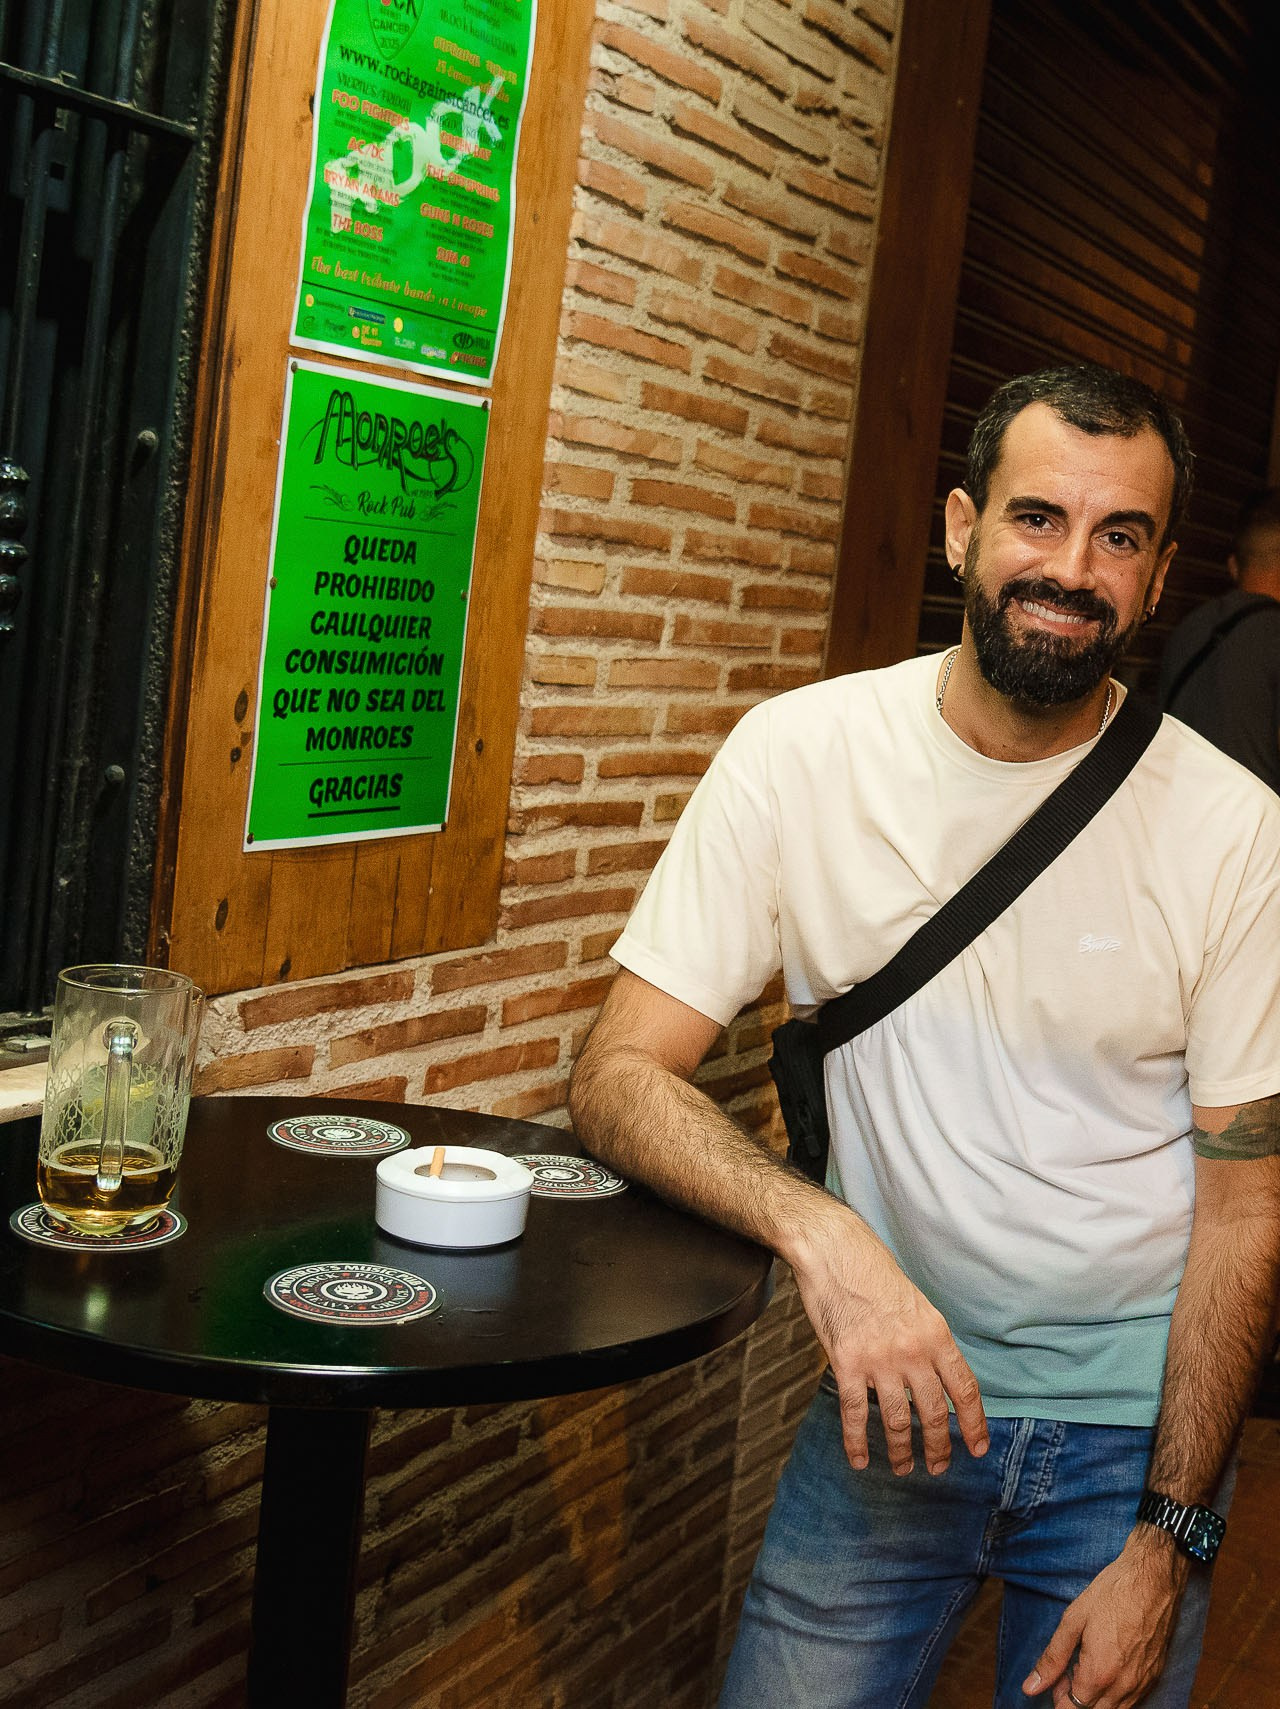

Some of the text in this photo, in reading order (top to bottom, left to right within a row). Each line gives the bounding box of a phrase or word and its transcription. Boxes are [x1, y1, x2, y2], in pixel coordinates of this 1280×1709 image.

[373, 19, 410, 34] CANCER
[332, 88, 359, 111] FOO
[361, 100, 409, 131] FIGHTERS
[347, 137, 384, 161] AC/DC
[324, 168, 359, 193] BRYAN
[362, 183, 400, 207] ADAMS
[426, 163, 444, 182] THE
[333, 213, 383, 242] THE BOSS
[421, 203, 450, 223] GUNS
[462, 216, 494, 238] ROSES
[312, 256, 331, 275] The
[334, 260, 359, 282] best
[361, 271, 400, 293] tribute
[404, 280, 435, 302] bands
[358, 491, 387, 516] Rock
[391, 496, 416, 520] Pub
[344, 534, 417, 565] QUEDA
[314, 571, 435, 602] PROHIBIDO
[310, 610, 432, 643] CAULQUIER
[285, 646, 444, 676] CONSUMICIÓN
[273, 688, 446, 719] QUE NO SEA DEL
[305, 725, 414, 752] MONROES
[309, 773, 403, 808] GRACIAS
[301, 1273, 340, 1287] ROCK
[344, 1265, 398, 1276] MUSIC
[396, 1274, 423, 1286] PUB
